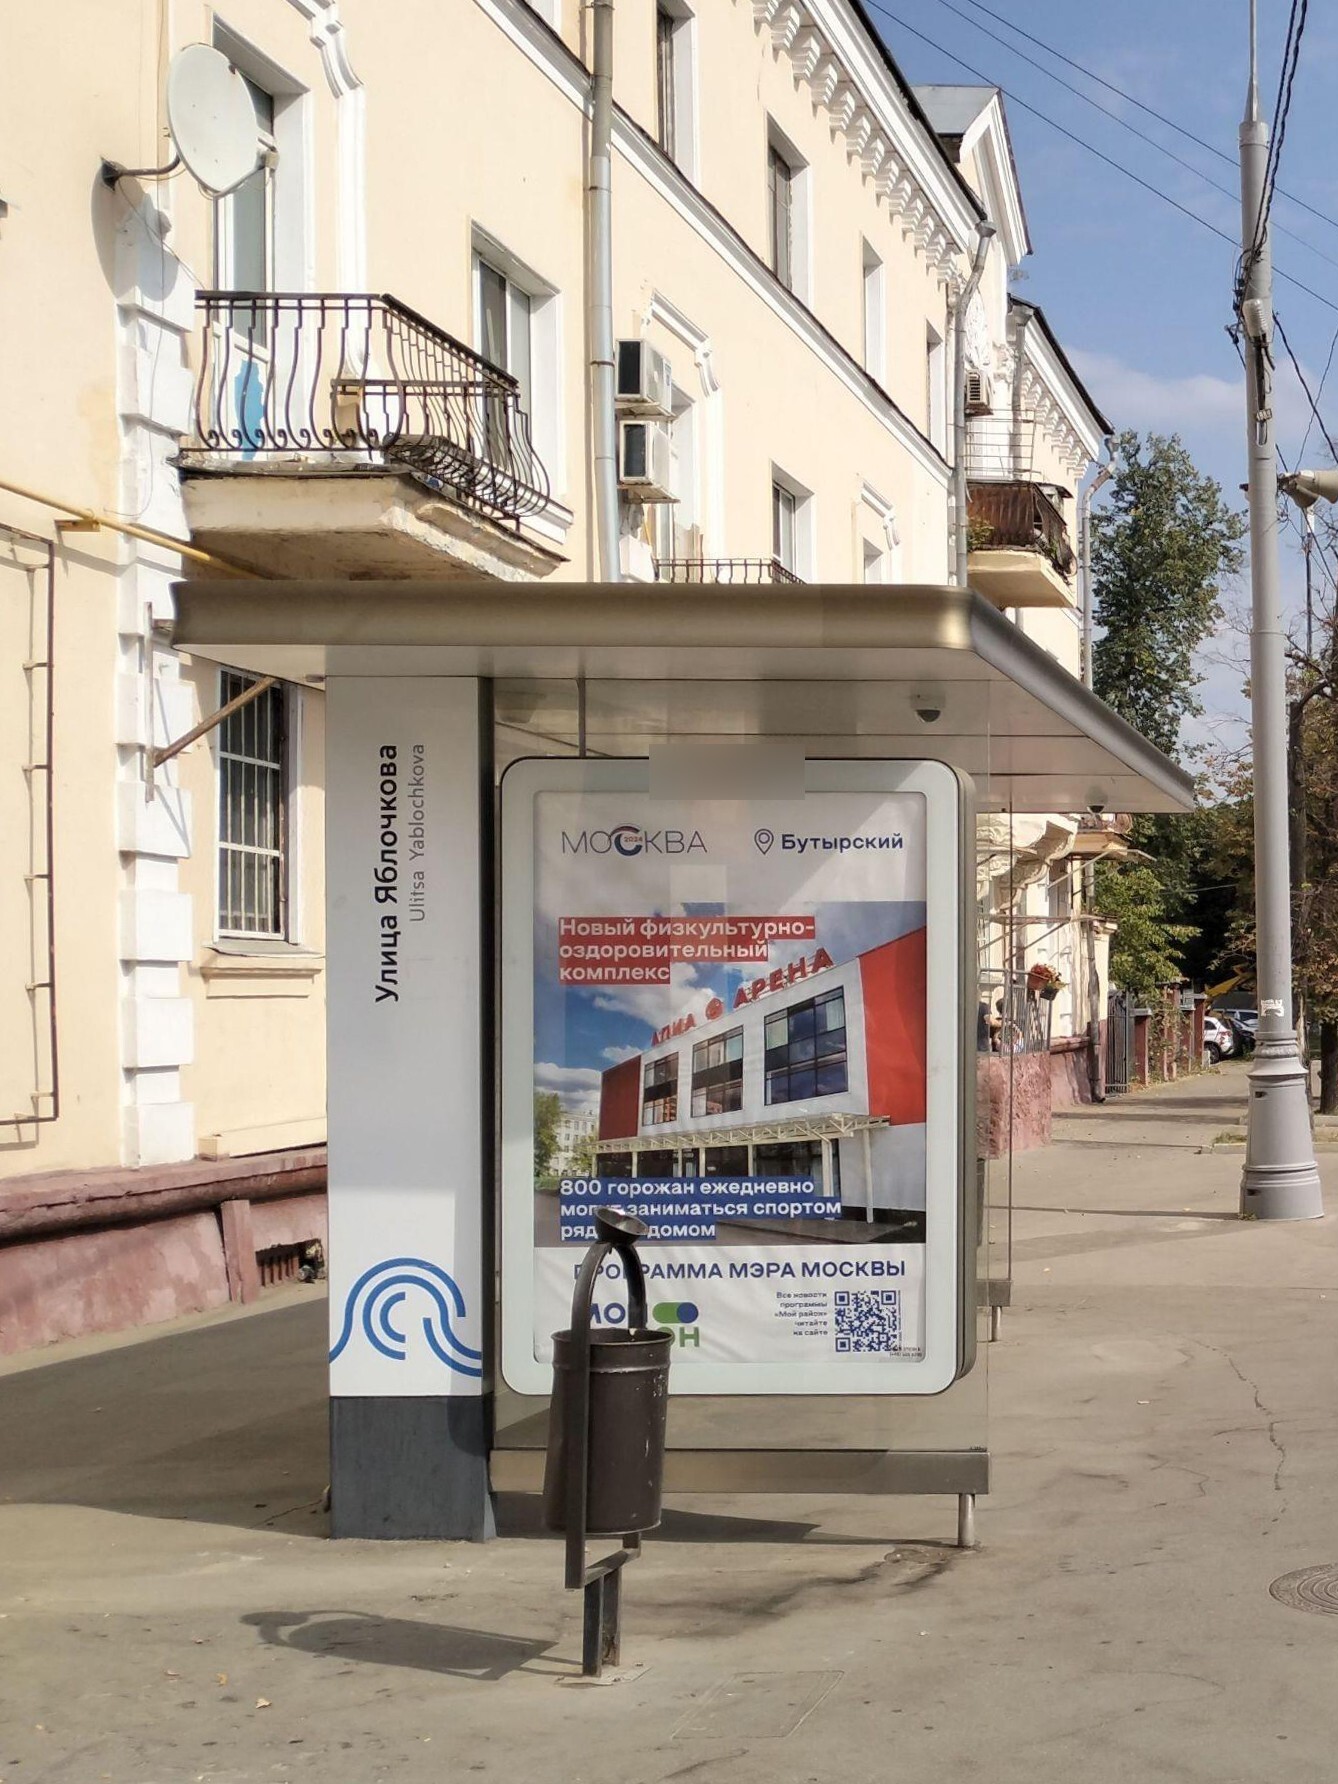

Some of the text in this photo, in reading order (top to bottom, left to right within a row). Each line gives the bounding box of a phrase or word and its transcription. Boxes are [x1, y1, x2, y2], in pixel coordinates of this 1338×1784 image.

[408, 744, 425, 922] Ulitsa Yablochkova
[561, 825, 707, 856] МОСКВА
[782, 833, 903, 853] Бутырский
[374, 744, 401, 1003] Улица Яблочкова
[559, 918, 815, 939] Новый физкультурно-
[559, 939, 768, 960] оздоровительный
[559, 966, 670, 980] комплекс
[733, 947, 836, 1009] АРЕНА
[560, 1179, 814, 1198] 800 горожан ежедневно
[560, 1201, 842, 1217] мог заниматься спортом
[560, 1224, 716, 1241] ряд домом
[729, 1262, 796, 1278] МЭРА
[801, 1260, 905, 1278] МОСКВЫ
